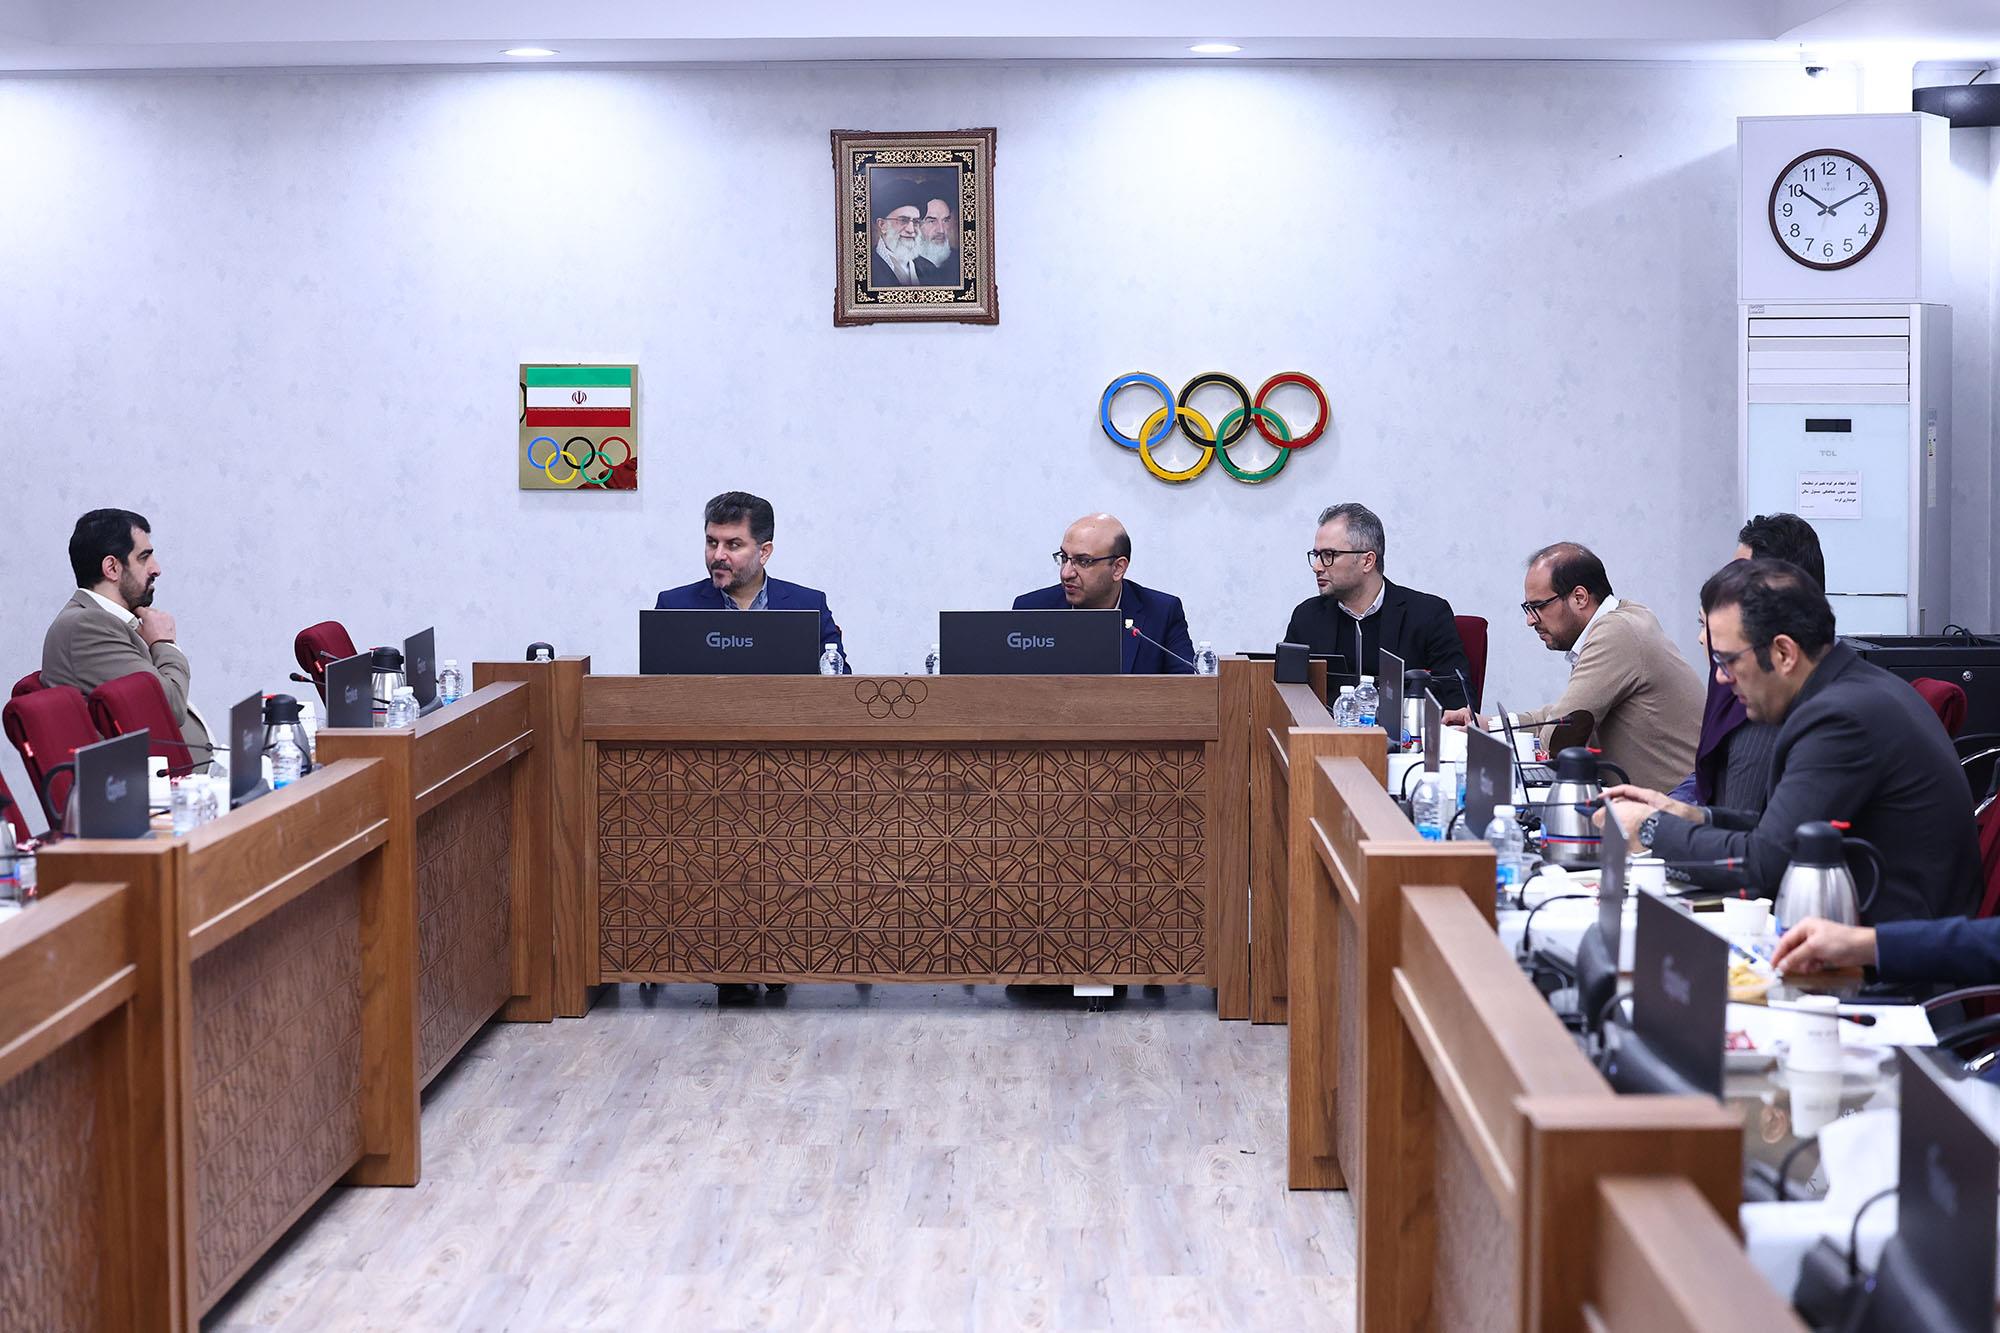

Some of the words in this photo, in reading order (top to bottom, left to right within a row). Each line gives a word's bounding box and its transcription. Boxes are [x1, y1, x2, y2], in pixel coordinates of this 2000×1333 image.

[1803, 168, 1816, 182] 11
[1820, 161, 1837, 176] 12
[1846, 167, 1851, 181] 1
[1788, 183, 1804, 198] 10
[1858, 181, 1869, 196] 2
[1782, 202, 1793, 217] 9
[1864, 201, 1875, 217] 3
[1790, 223, 1801, 238] 8
[1857, 223, 1868, 237] 4
[1804, 238, 1815, 252] 7
[1823, 242, 1834, 257] 6
[1843, 238, 1853, 252] 5
[705, 631, 754, 650] Gplus
[1007, 632, 1055, 651] Gplus
